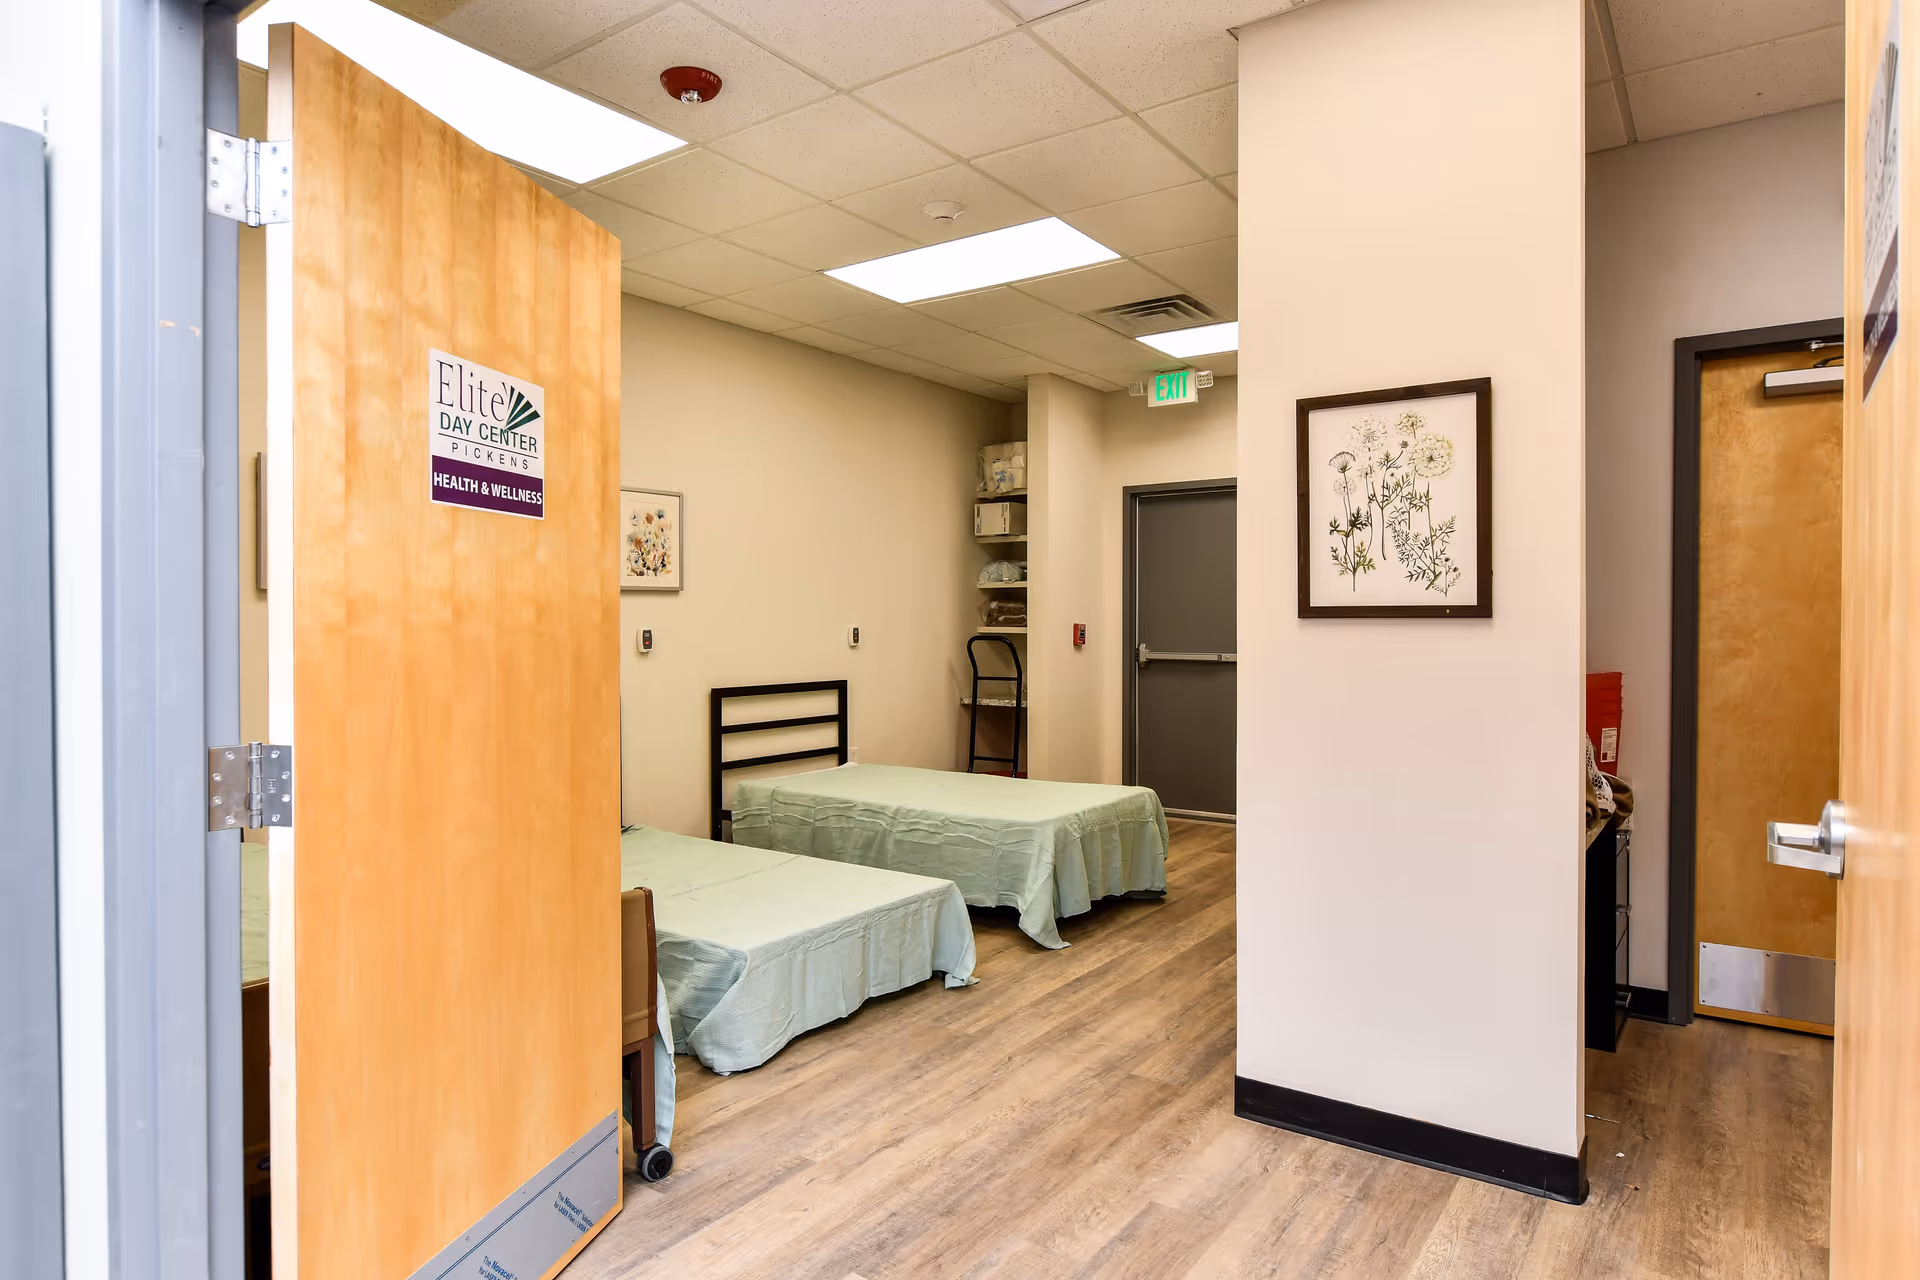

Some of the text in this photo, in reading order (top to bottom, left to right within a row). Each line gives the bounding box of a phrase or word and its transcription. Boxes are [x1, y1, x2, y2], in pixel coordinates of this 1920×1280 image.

[701, 71, 718, 84] FIRE
[436, 360, 505, 422] Elite
[1155, 371, 1189, 401] EXIT
[440, 412, 537, 453] DAY CENTER
[452, 442, 529, 470] PICKENS
[434, 471, 543, 505] HEALTH & WELLNESS
